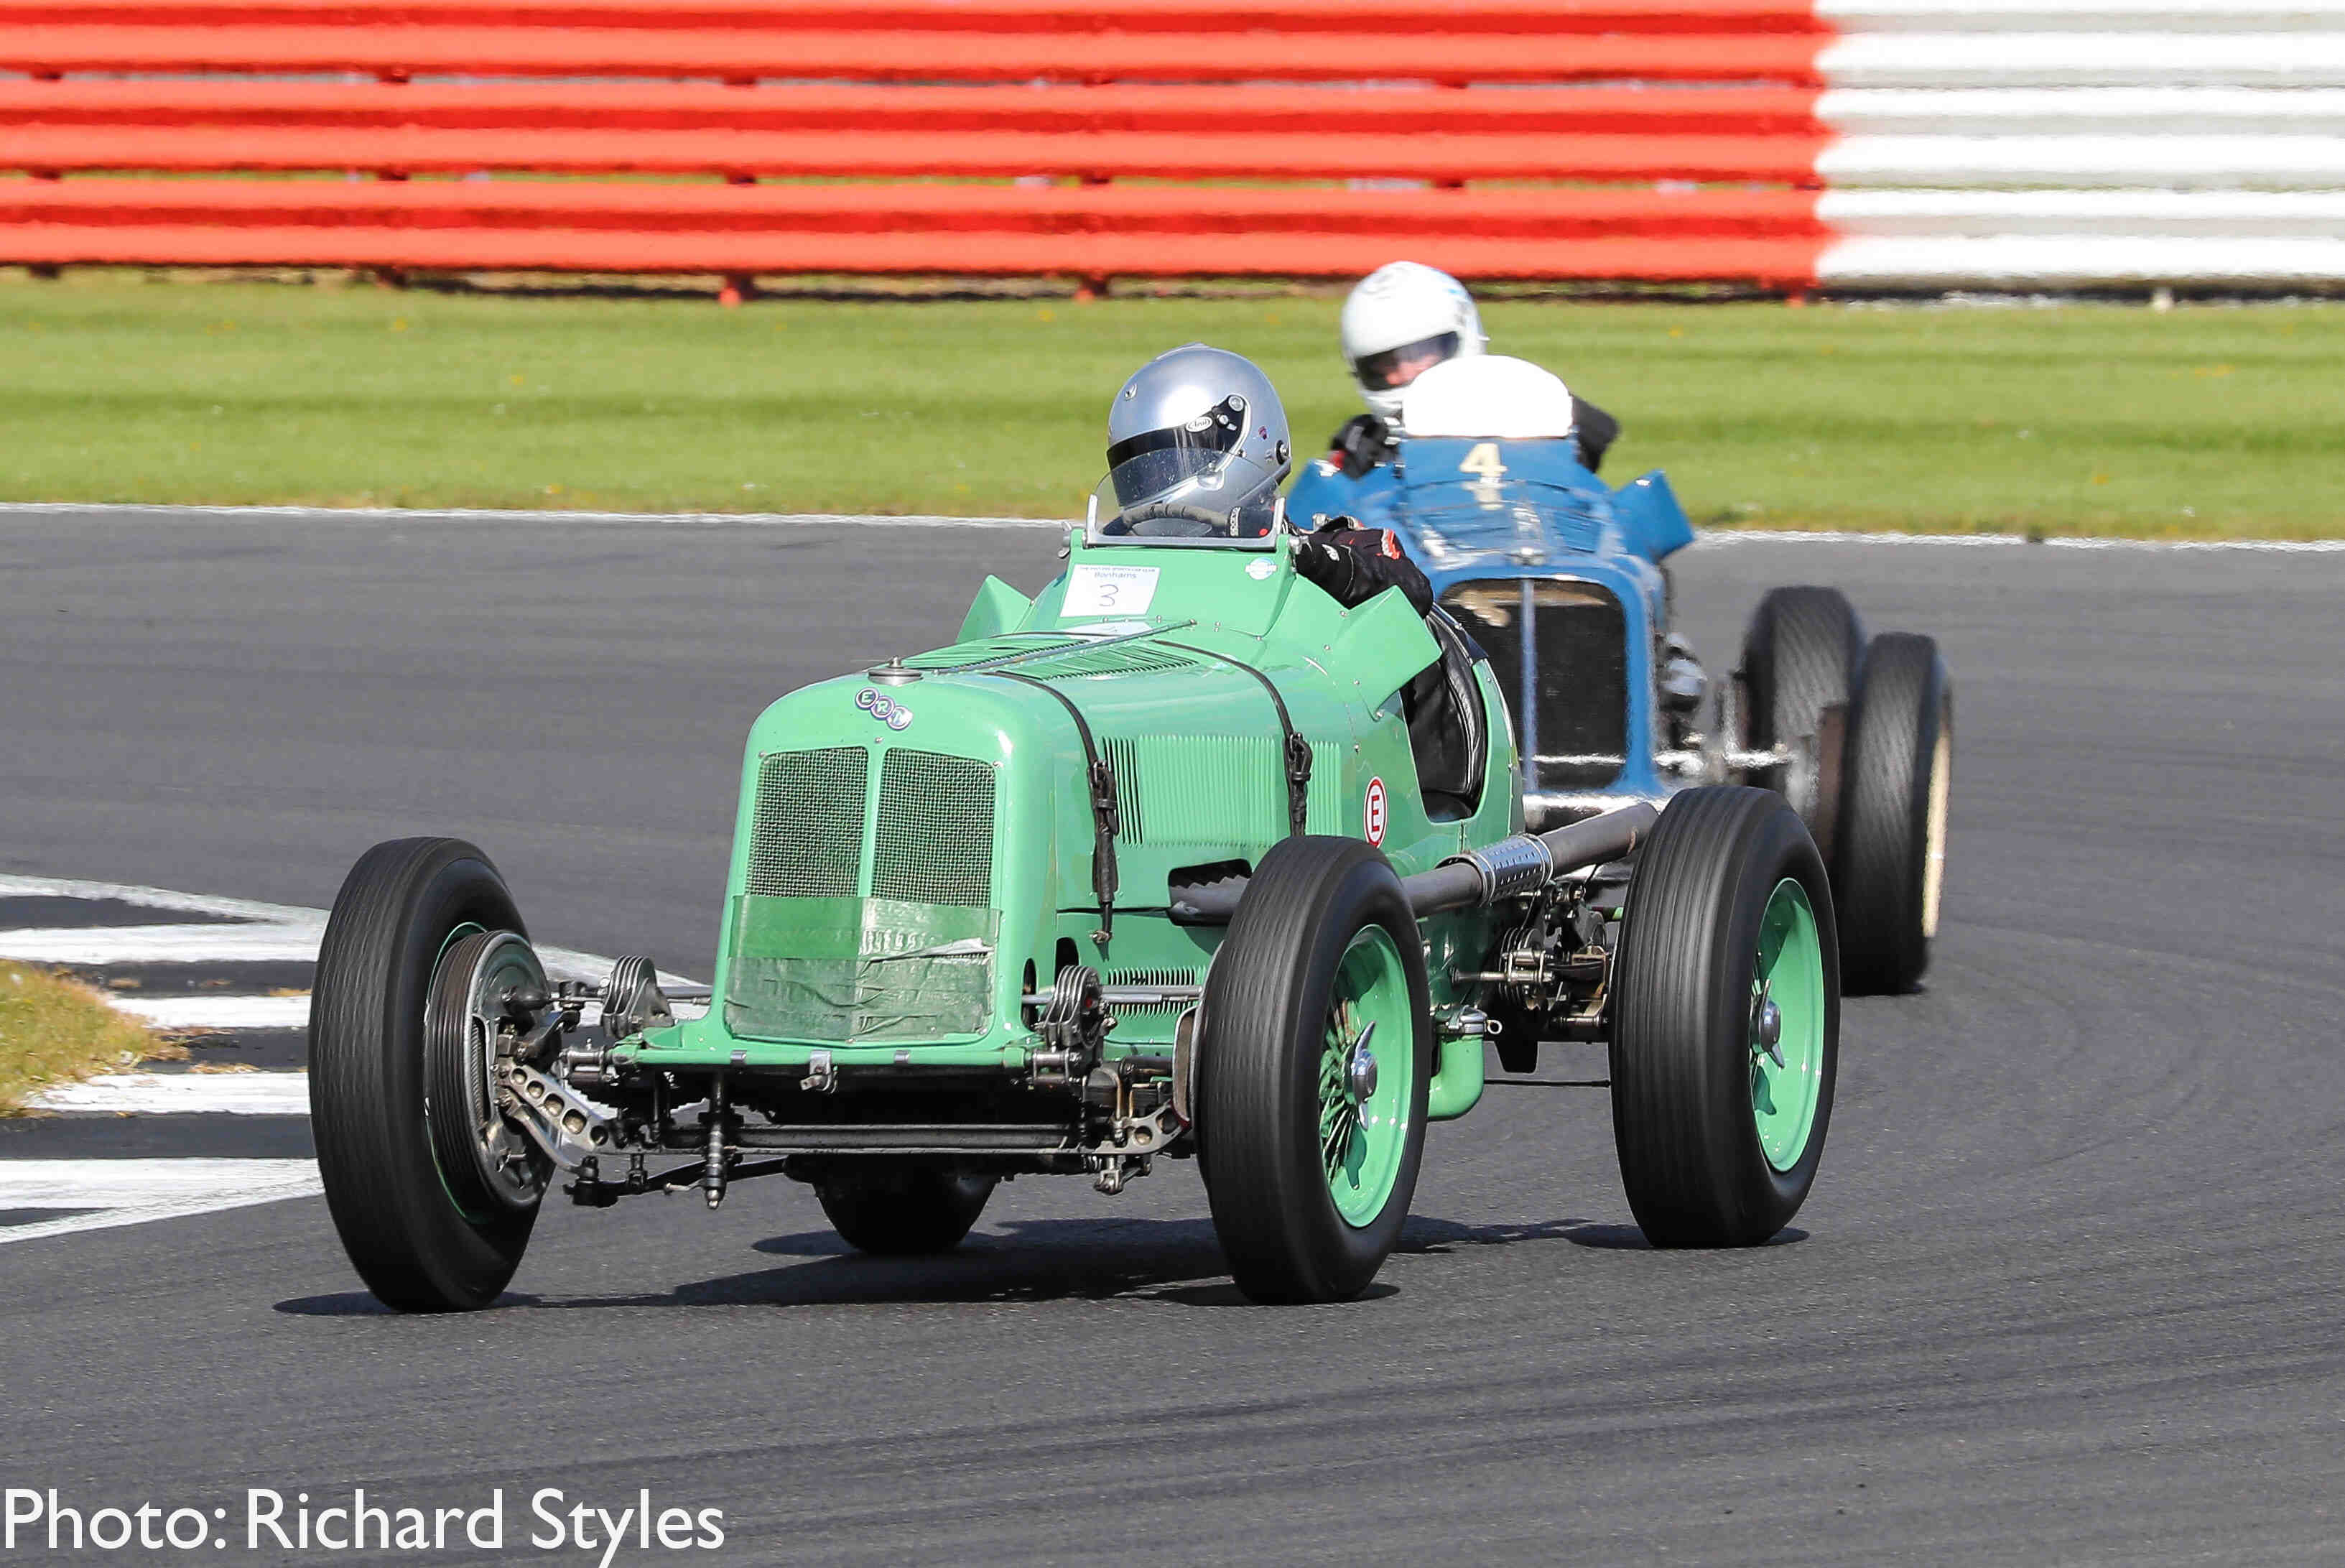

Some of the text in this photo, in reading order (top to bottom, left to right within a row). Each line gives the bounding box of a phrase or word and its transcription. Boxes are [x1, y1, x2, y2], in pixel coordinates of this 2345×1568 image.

[1459, 442, 1508, 488] 4
[1099, 583, 1119, 607] 3
[1371, 794, 1380, 833] E
